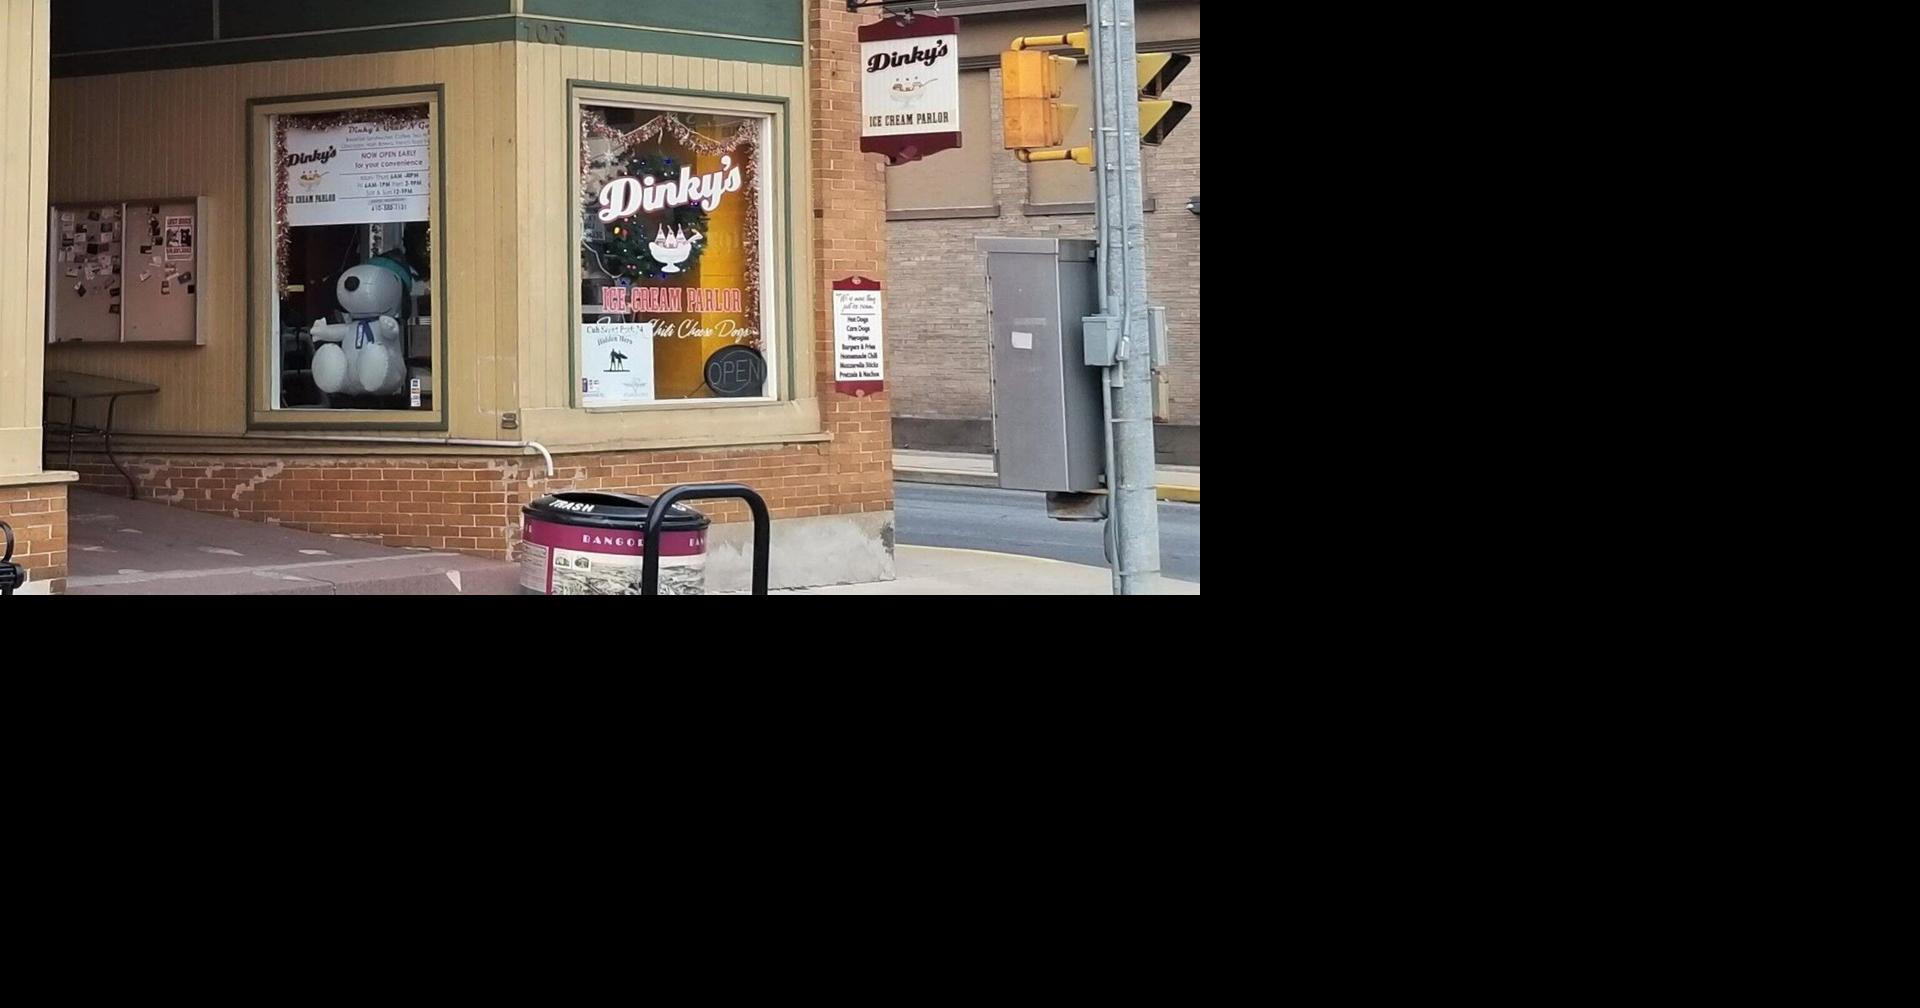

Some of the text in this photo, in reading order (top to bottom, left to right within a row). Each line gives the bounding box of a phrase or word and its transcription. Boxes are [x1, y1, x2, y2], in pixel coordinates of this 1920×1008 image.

[867, 39, 949, 73] Dinky's
[869, 111, 949, 127] ICE CREAM PARLOR
[287, 146, 337, 168] Dinky's
[361, 151, 377, 159] NOW
[399, 149, 416, 157] EARLY
[365, 162, 379, 170] your
[381, 160, 423, 168] convenience
[599, 155, 742, 223] Dinky's
[296, 195, 314, 204] CREAM
[315, 194, 337, 203] PARLOR
[602, 286, 742, 313] ICE CREAM PARLOR
[857, 316, 869, 324] Dogs
[678, 318, 713, 339] Cheese
[714, 318, 751, 344] Dogs
[858, 325, 870, 333] Dogs
[842, 344, 860, 352] Burgers
[707, 358, 767, 386] OPEN
[549, 499, 595, 513] TRASH
